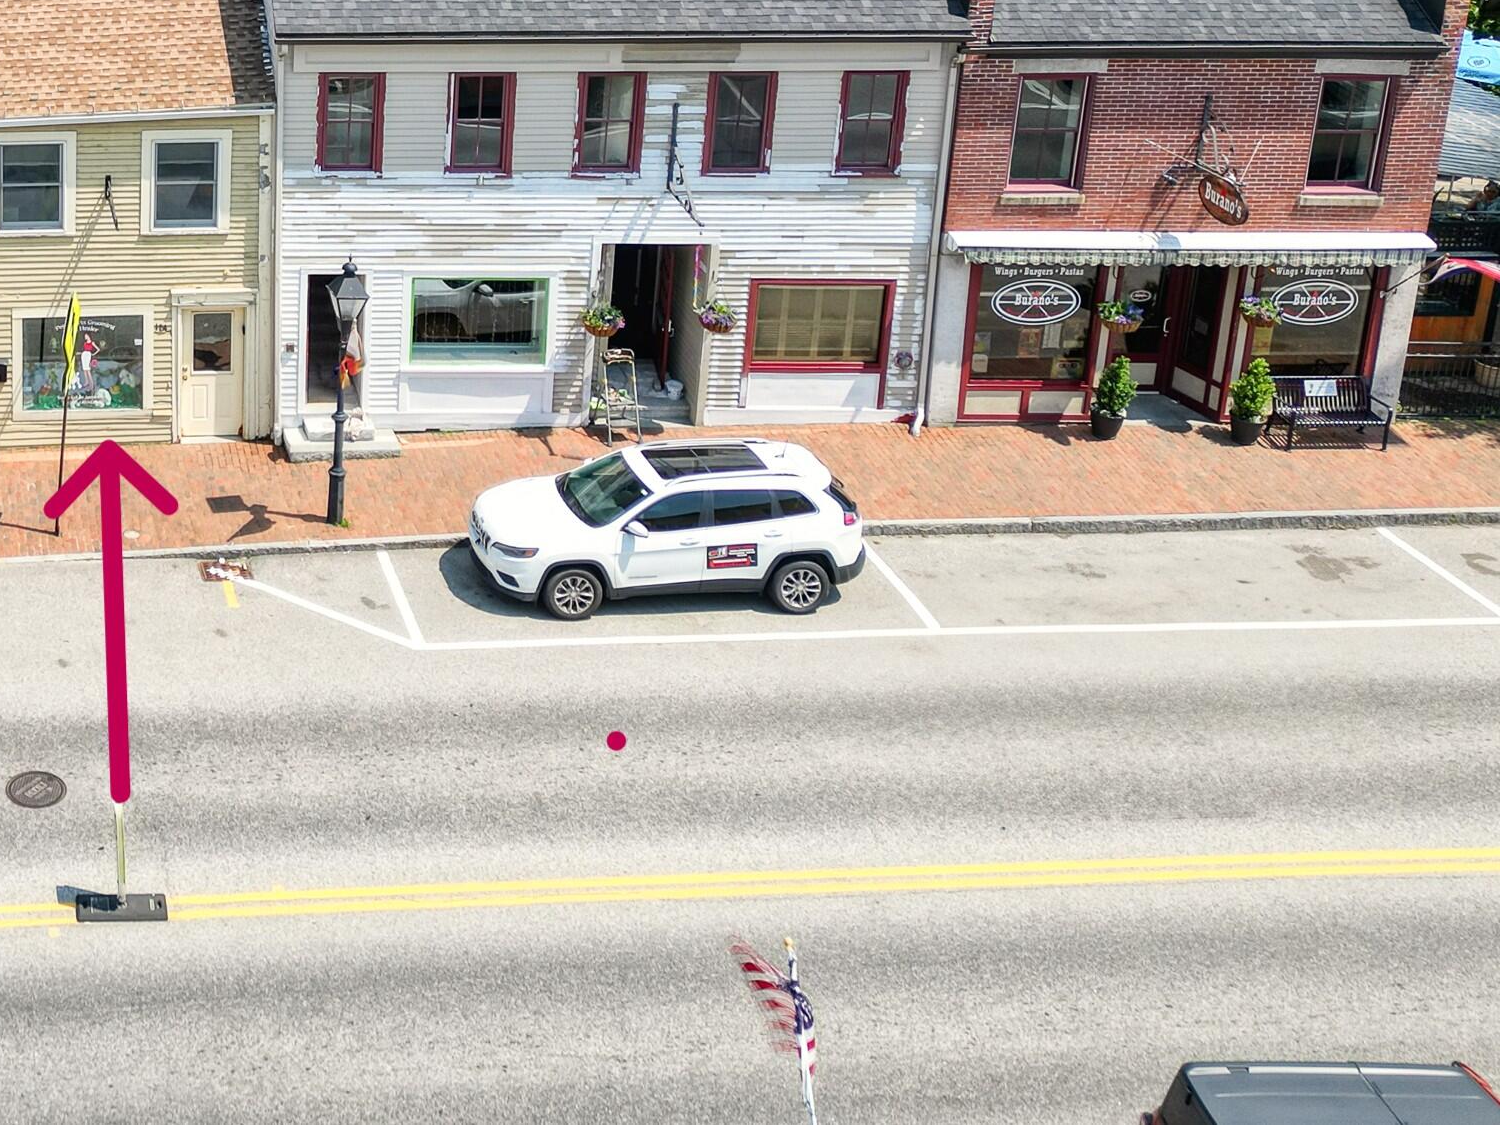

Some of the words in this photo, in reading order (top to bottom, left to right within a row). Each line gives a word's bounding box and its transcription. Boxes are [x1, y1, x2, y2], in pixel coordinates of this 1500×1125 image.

[1205, 181, 1242, 218] Burano's
[995, 267, 1017, 277] Wings
[1024, 267, 1053, 277] Burgers
[1060, 267, 1084, 275] Pastas
[1276, 267, 1298, 277] Wings
[1305, 267, 1334, 277] Burgers
[1340, 266, 1364, 275] Pastas
[1014, 293, 1059, 306] Burano's
[1293, 293, 1337, 306] Burano's
